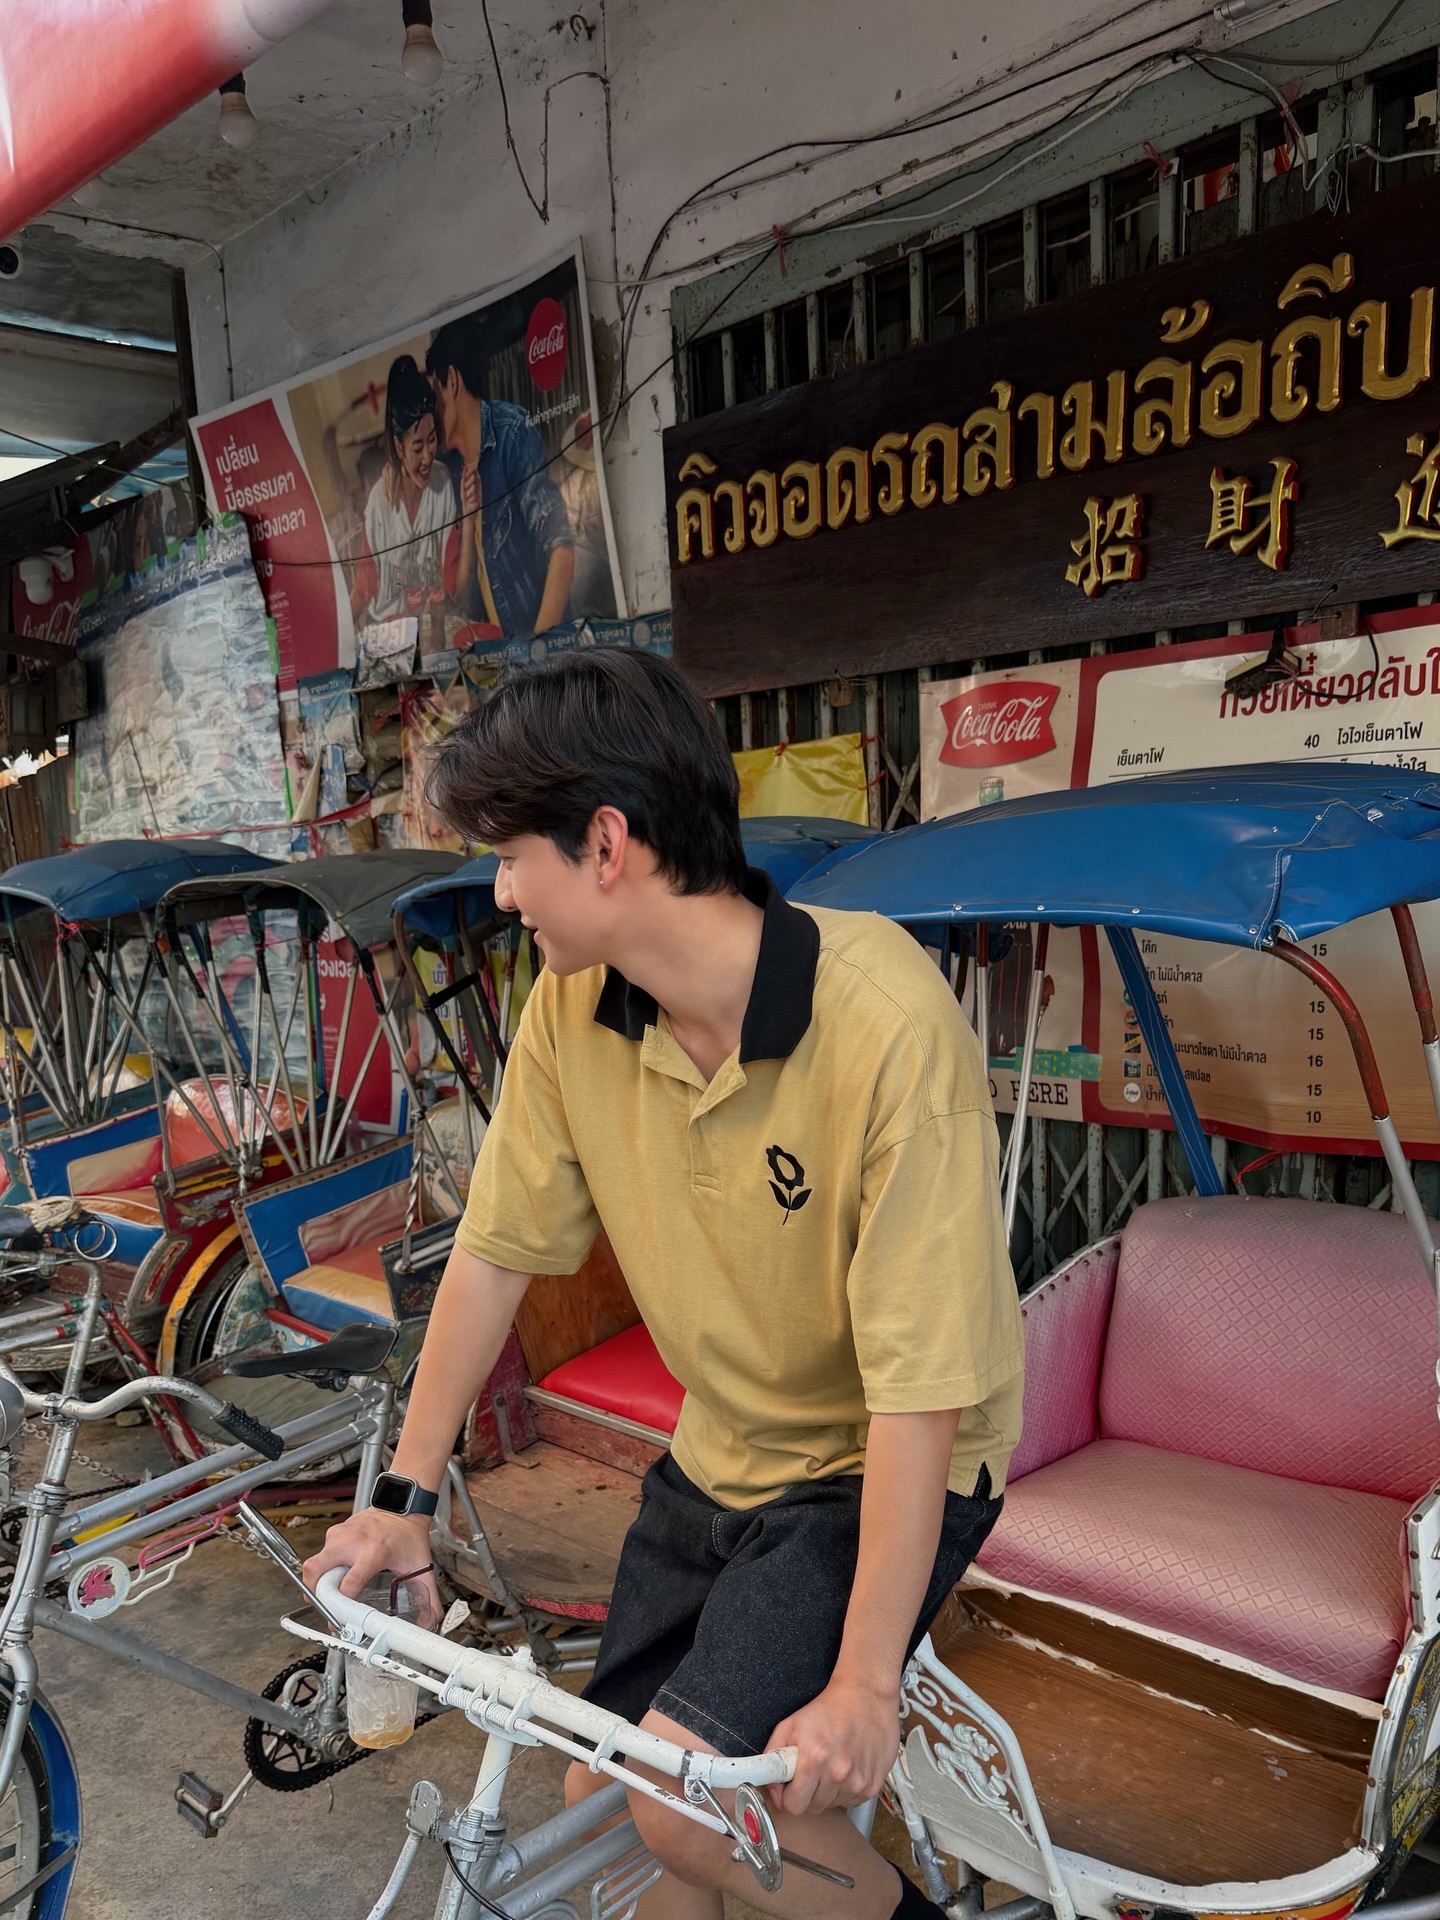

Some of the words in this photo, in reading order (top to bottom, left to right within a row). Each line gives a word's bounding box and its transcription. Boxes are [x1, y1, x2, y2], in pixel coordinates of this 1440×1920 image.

[675, 252, 1437, 564] คิวจอดรถสามล้อถีบ
[216, 436, 260, 476] เปลี่ยน
[978, 702, 998, 712] DRINK
[952, 696, 1049, 750] Coca-Cola
[1116, 747, 1165, 767] เย็นตาโฟ
[1303, 733, 1320, 748] 40
[1337, 721, 1423, 745] ไวไวเย็นตาโฟ
[1311, 944, 1328, 957] 15
[1158, 965, 1203, 983] ไม่มีน้ำตาล
[1309, 1001, 1325, 1014] 15
[1308, 1028, 1324, 1041] 15
[1307, 1055, 1323, 1068] 16
[1306, 1084, 1322, 1097] 15
[1305, 1110, 1321, 1124] 10
